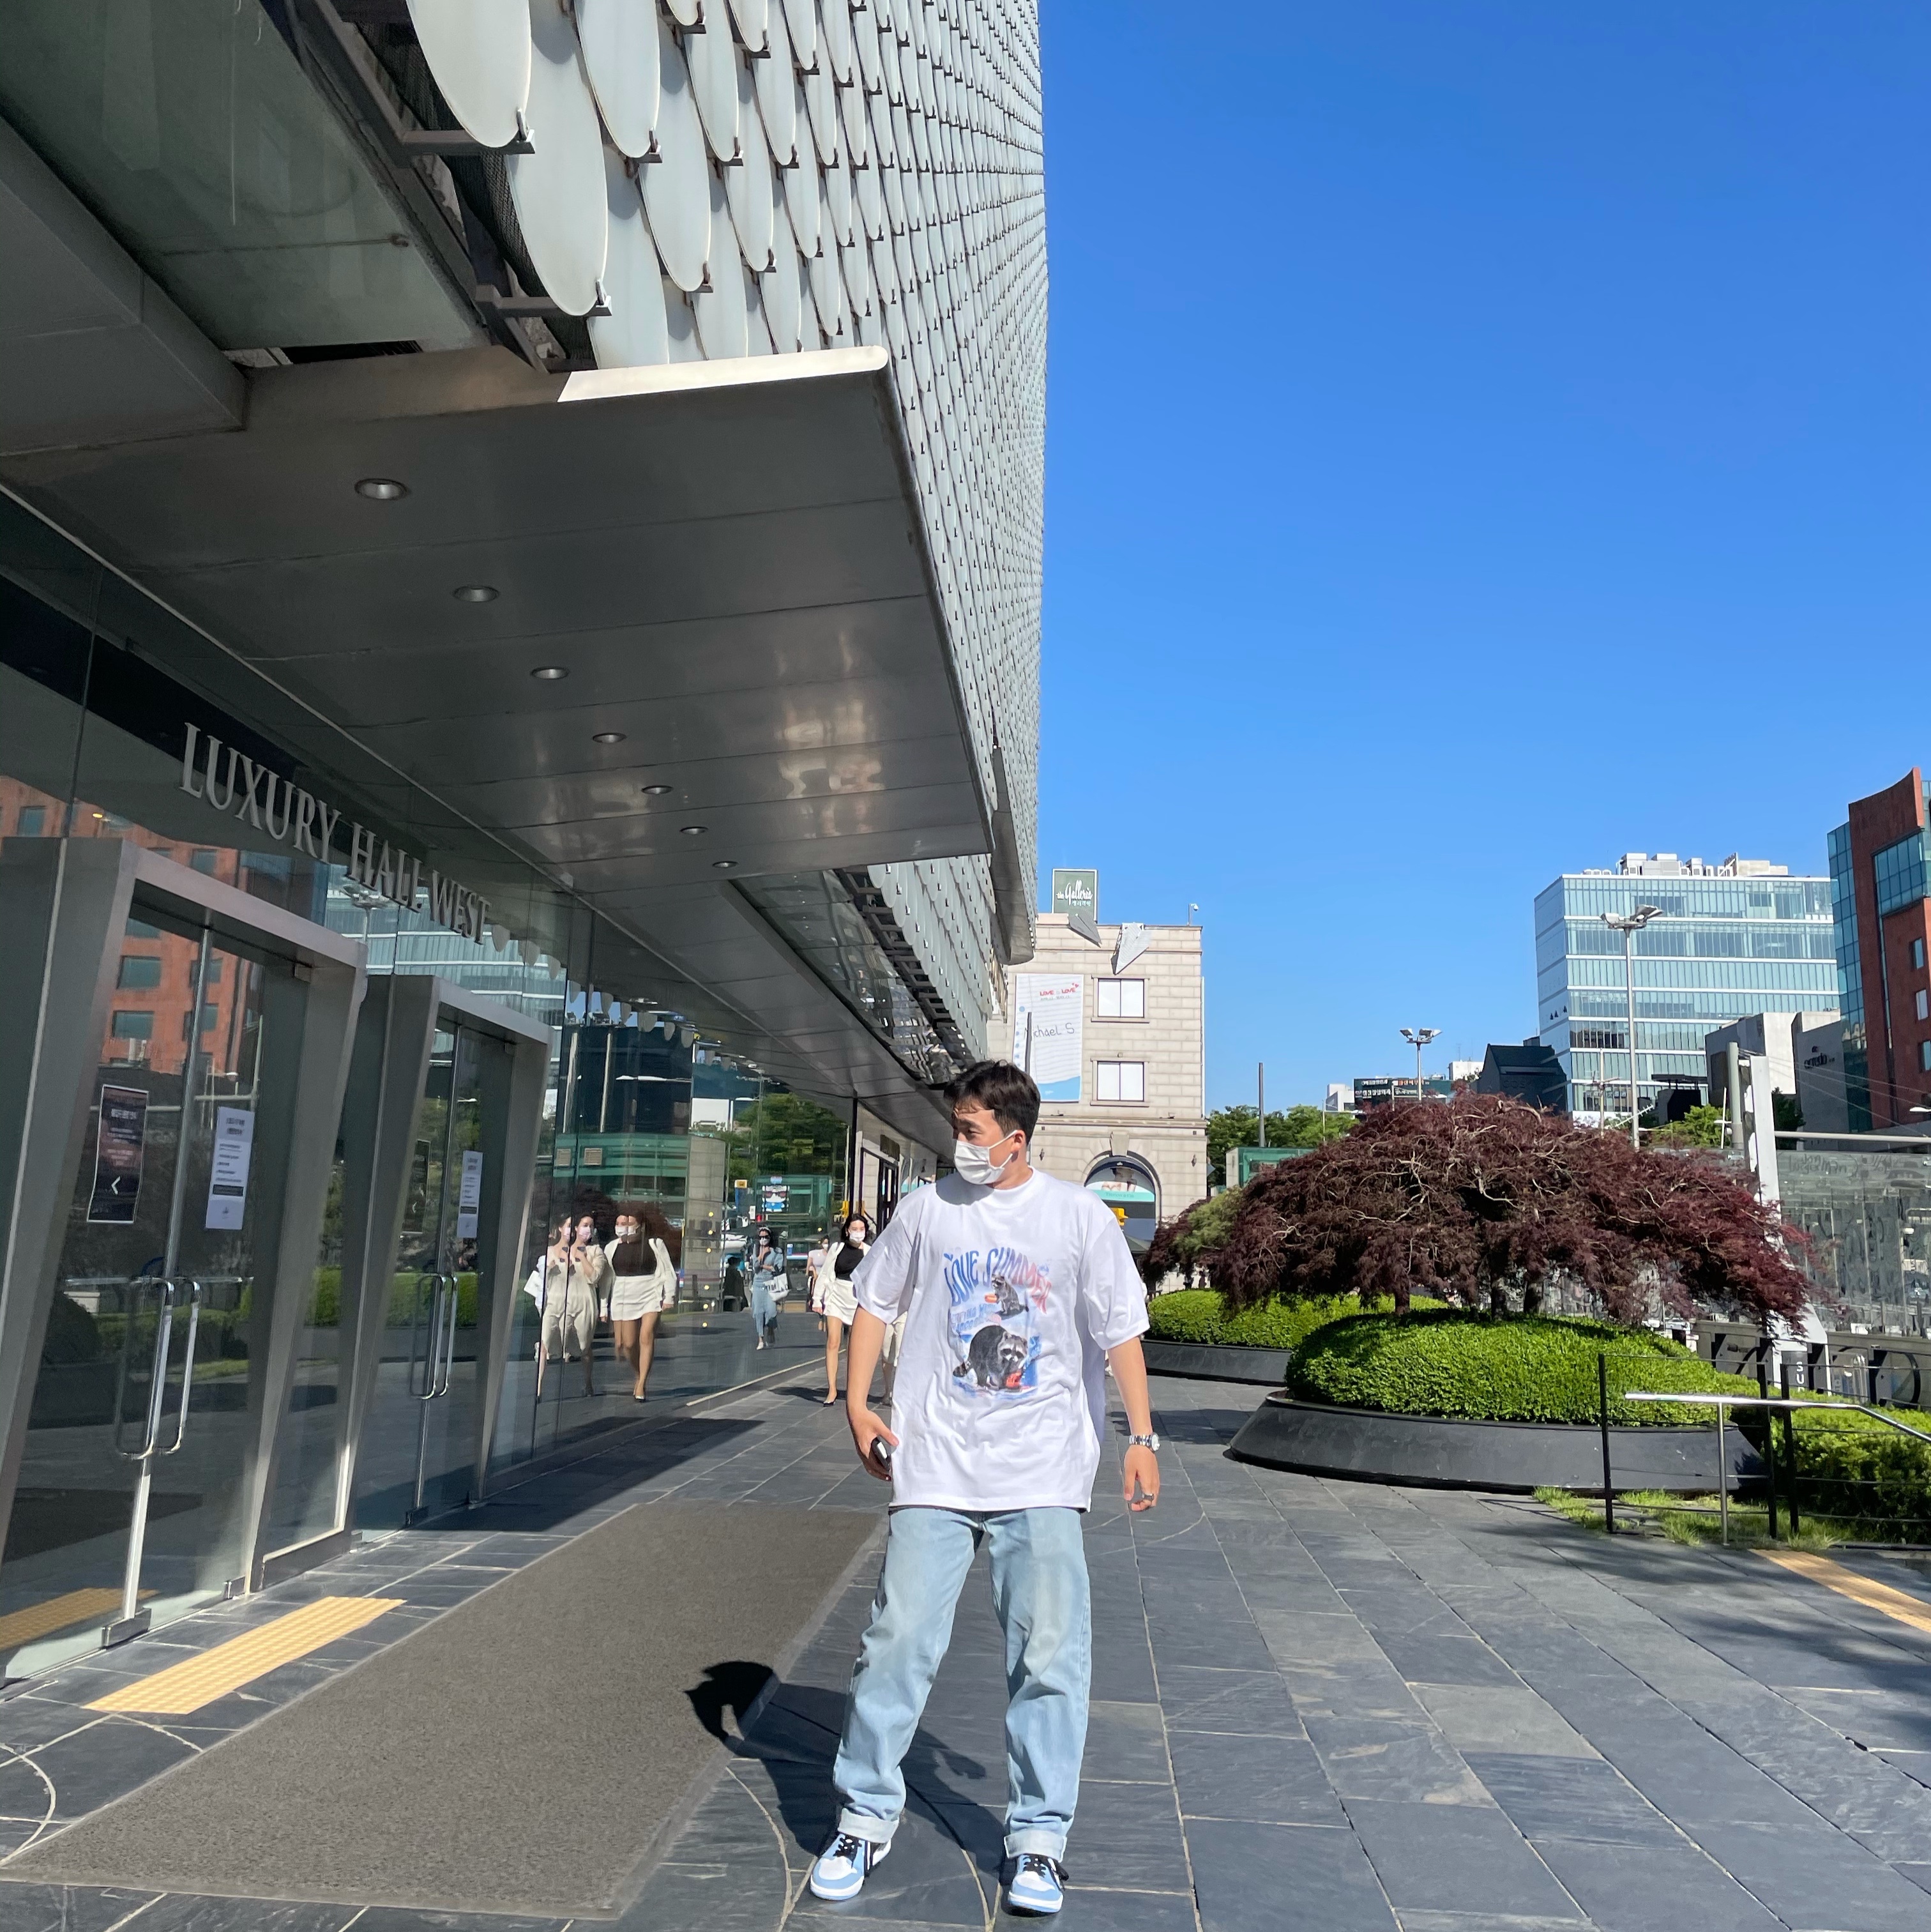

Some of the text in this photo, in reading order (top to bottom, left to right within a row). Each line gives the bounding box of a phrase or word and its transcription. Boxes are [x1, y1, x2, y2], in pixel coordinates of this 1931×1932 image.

[180, 722, 492, 945] LUXURY HALL WEST
[944, 1250, 979, 1307] LOVE
